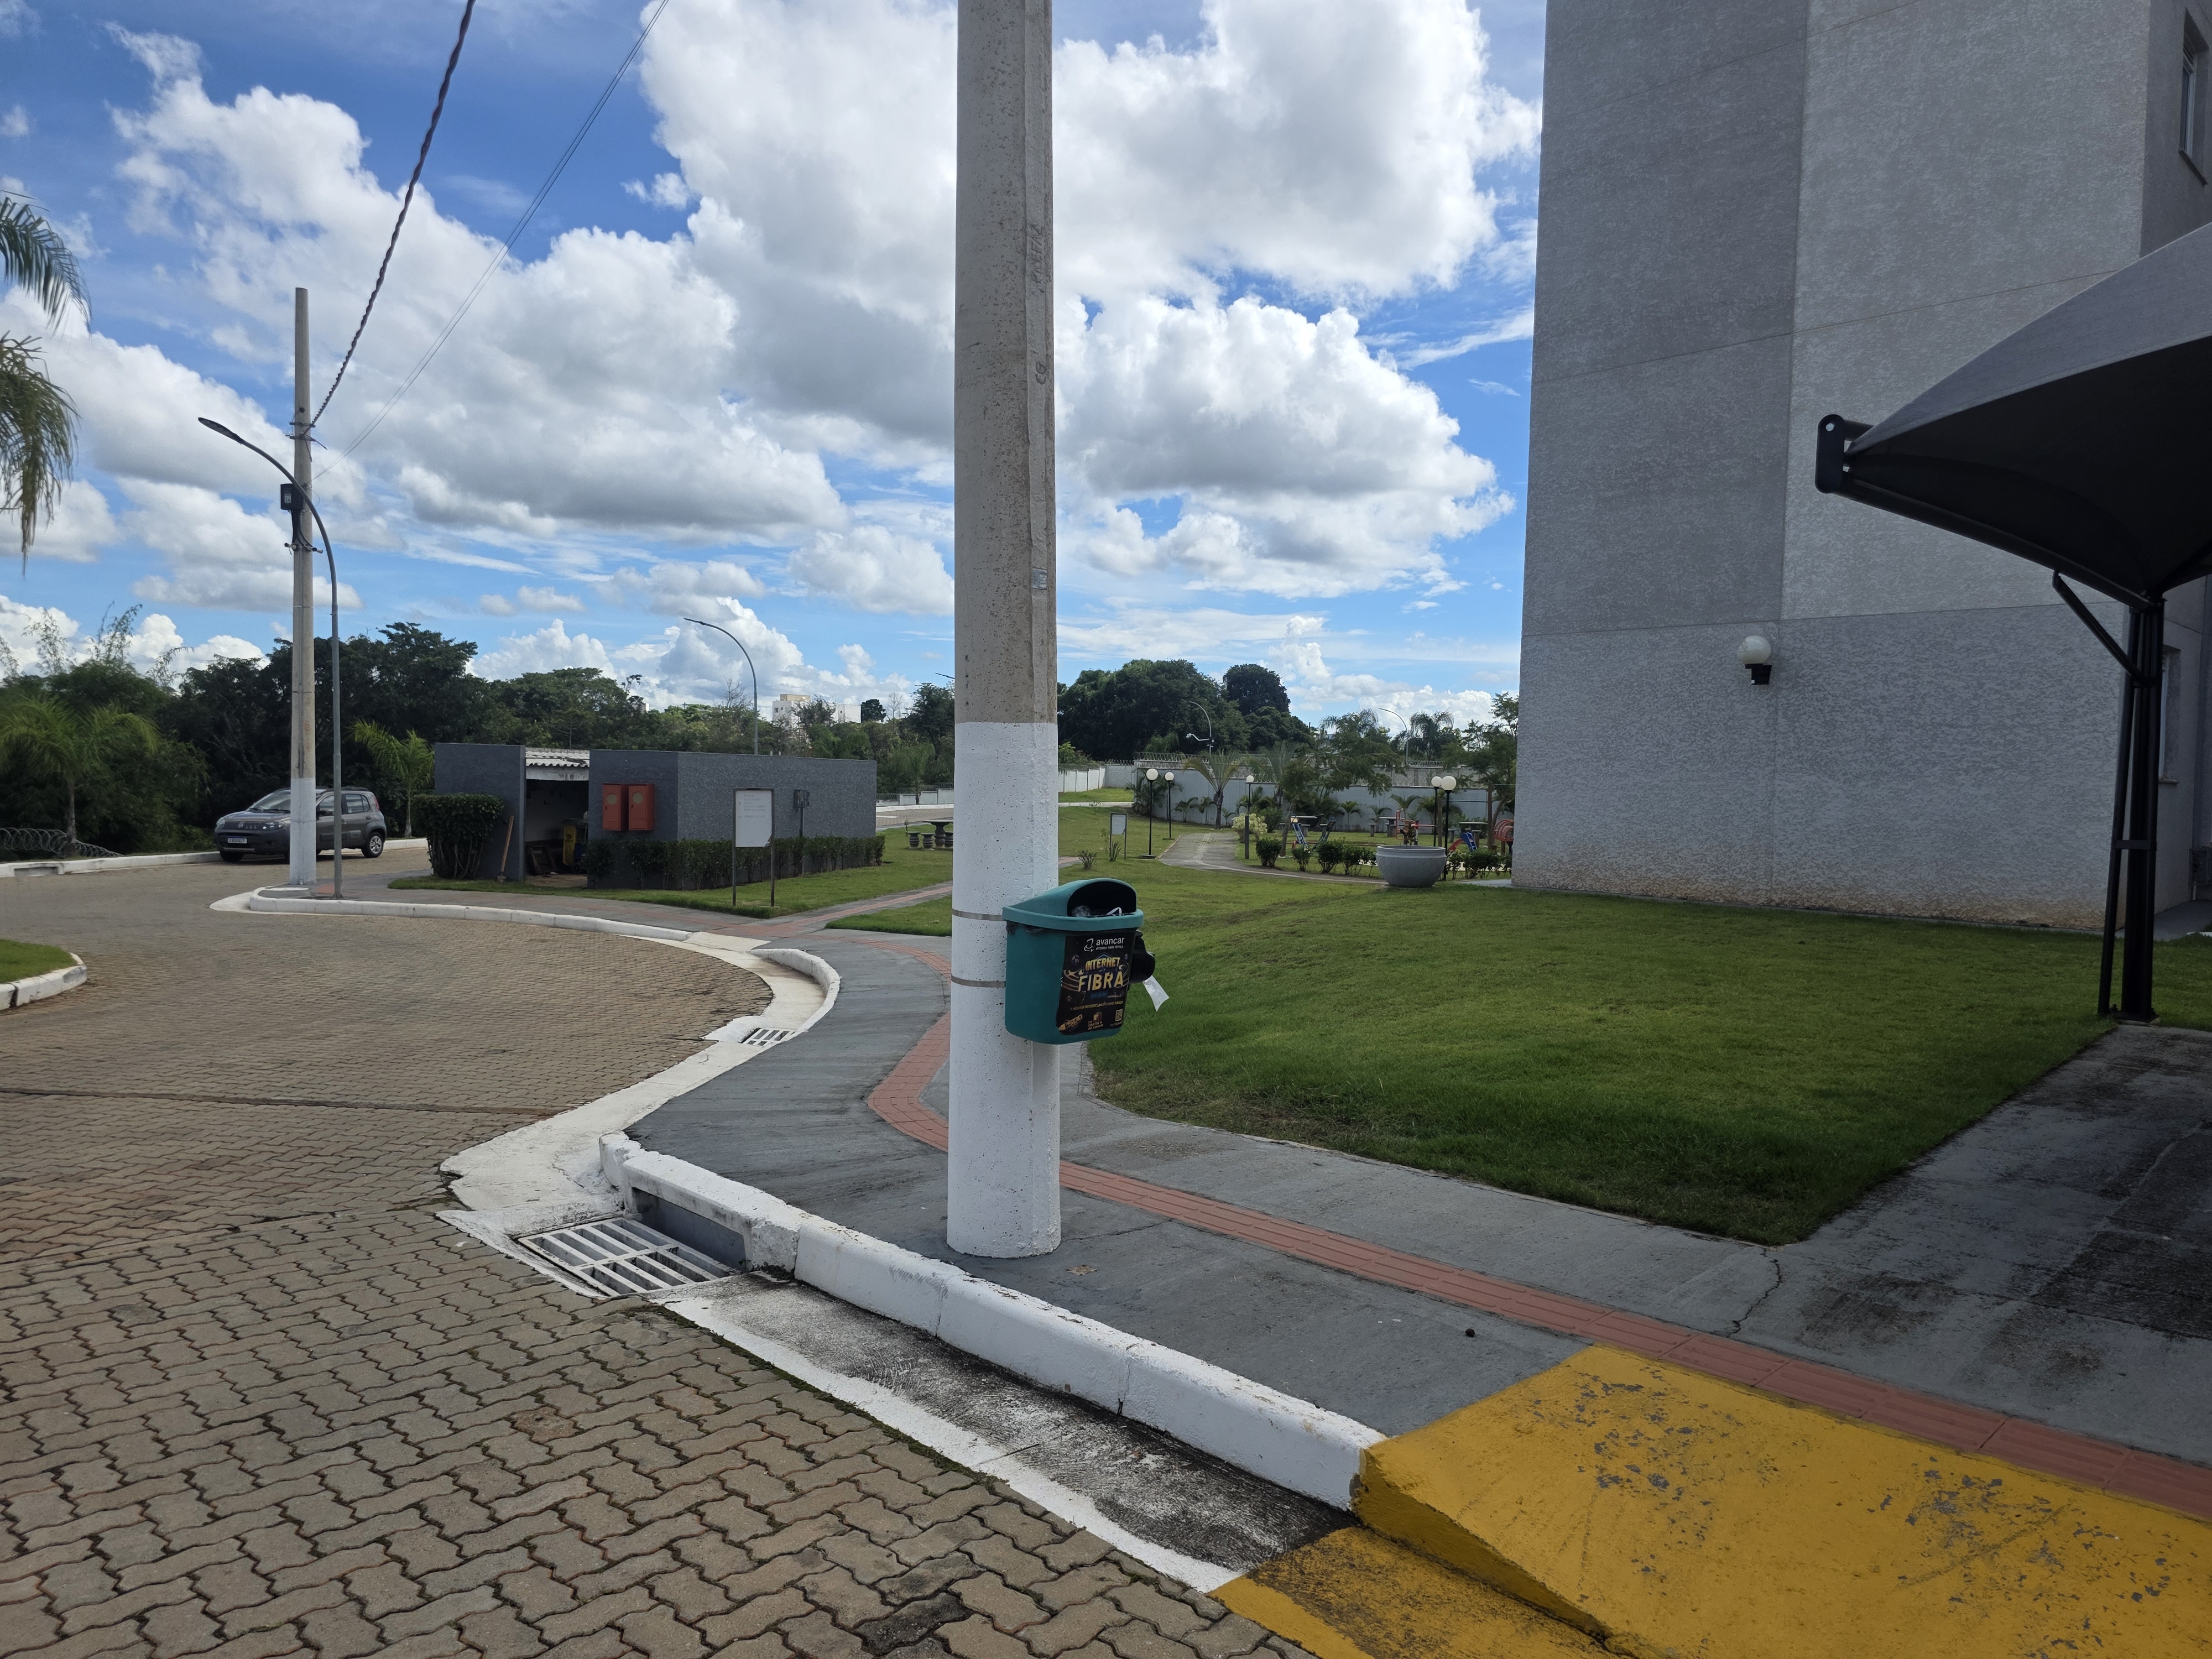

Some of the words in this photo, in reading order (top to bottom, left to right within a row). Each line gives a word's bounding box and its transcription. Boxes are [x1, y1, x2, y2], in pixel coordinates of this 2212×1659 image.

[1095, 937, 1125, 946] avancar
[1085, 957, 1120, 971] INTERNET
[1078, 971, 1123, 992] FIBRA
